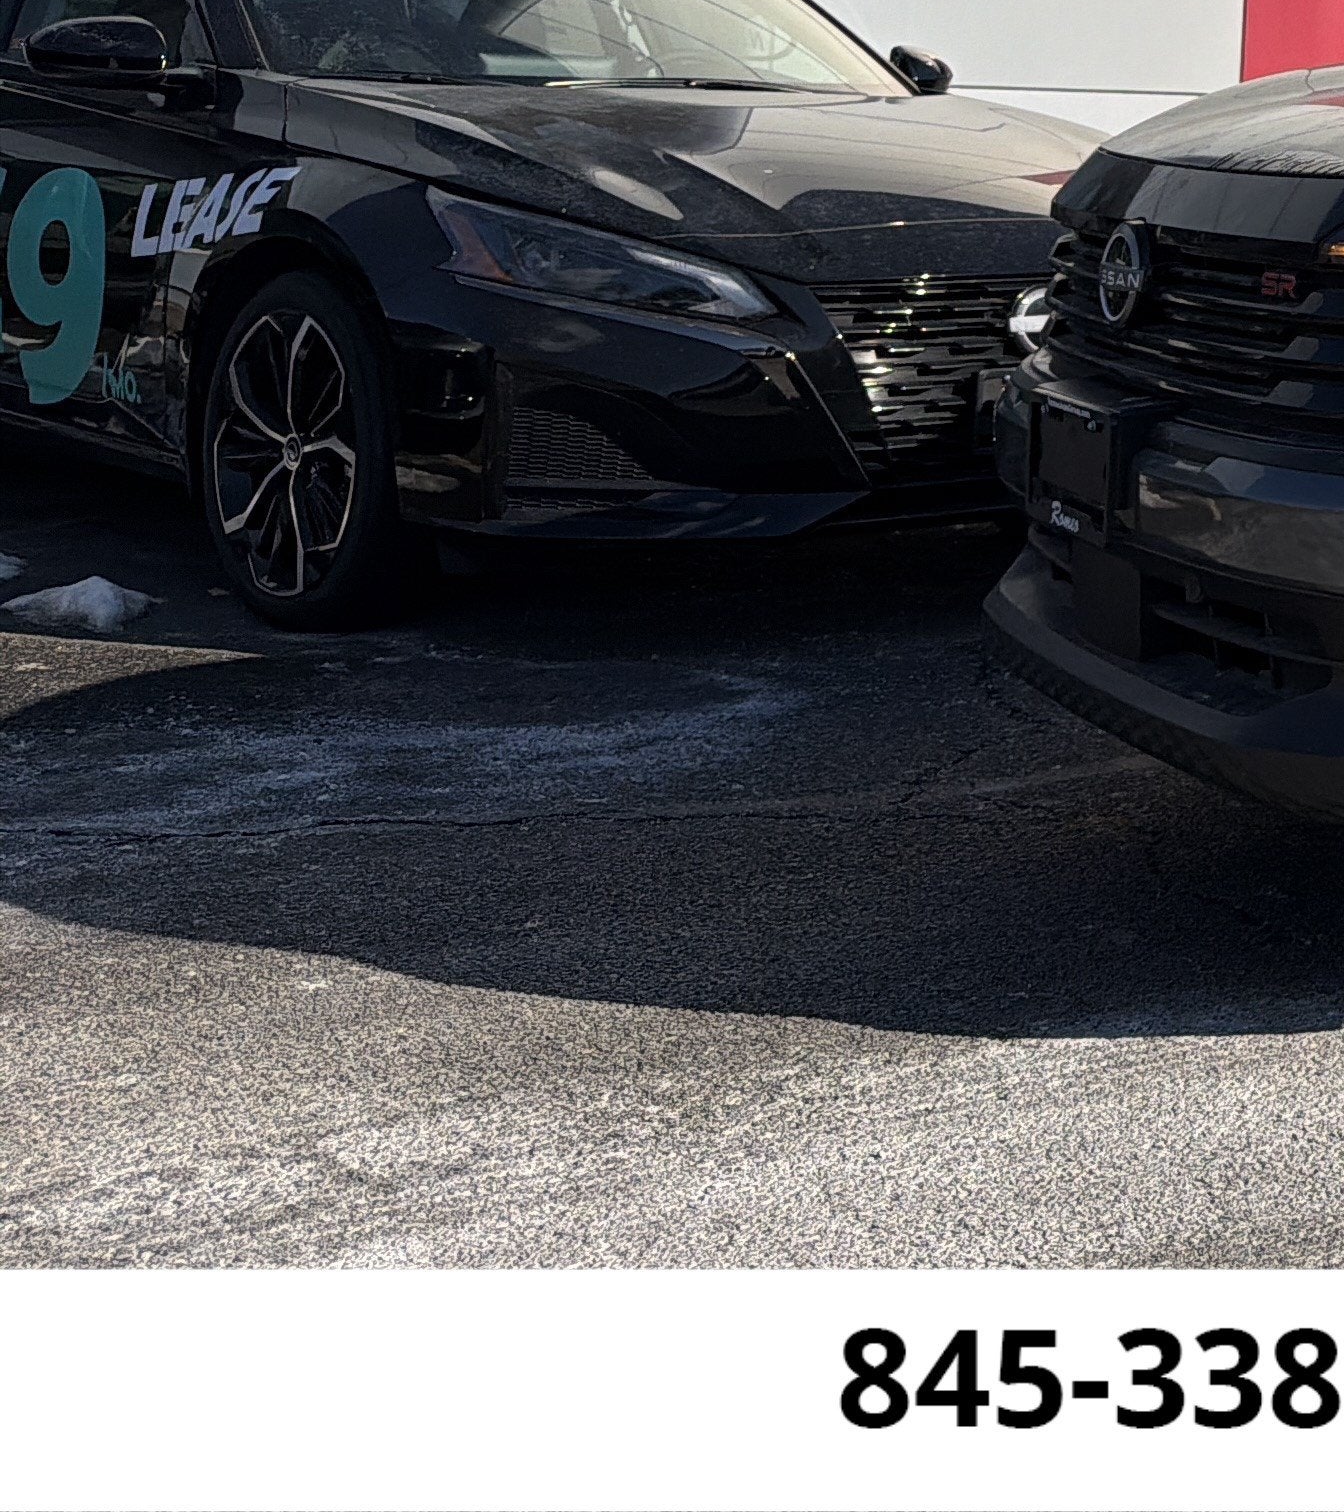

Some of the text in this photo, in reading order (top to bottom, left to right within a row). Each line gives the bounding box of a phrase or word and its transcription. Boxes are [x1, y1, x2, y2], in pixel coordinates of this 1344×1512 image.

[131, 166, 302, 258] LEASE
[0, 167, 107, 405] 9
[1261, 271, 1297, 299] SR
